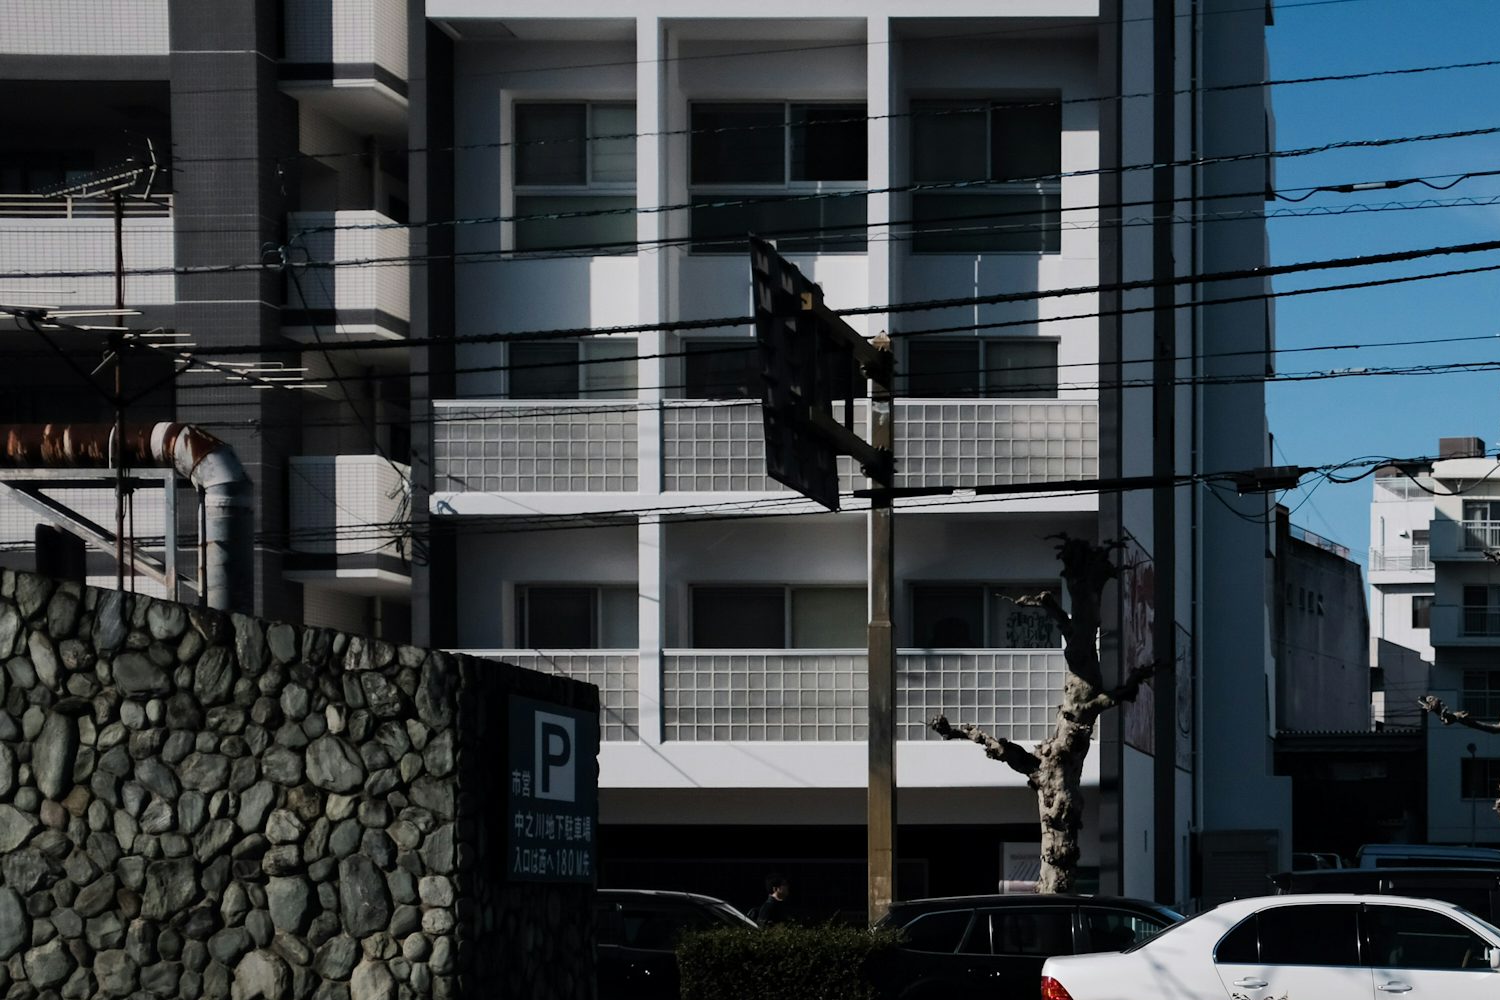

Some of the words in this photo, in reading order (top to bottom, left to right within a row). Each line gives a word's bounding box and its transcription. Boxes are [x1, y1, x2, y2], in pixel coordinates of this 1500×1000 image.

[542, 721, 571, 793] P
[512, 769, 531, 797] 市営
[513, 809, 591, 843] 中之川地下駐車場
